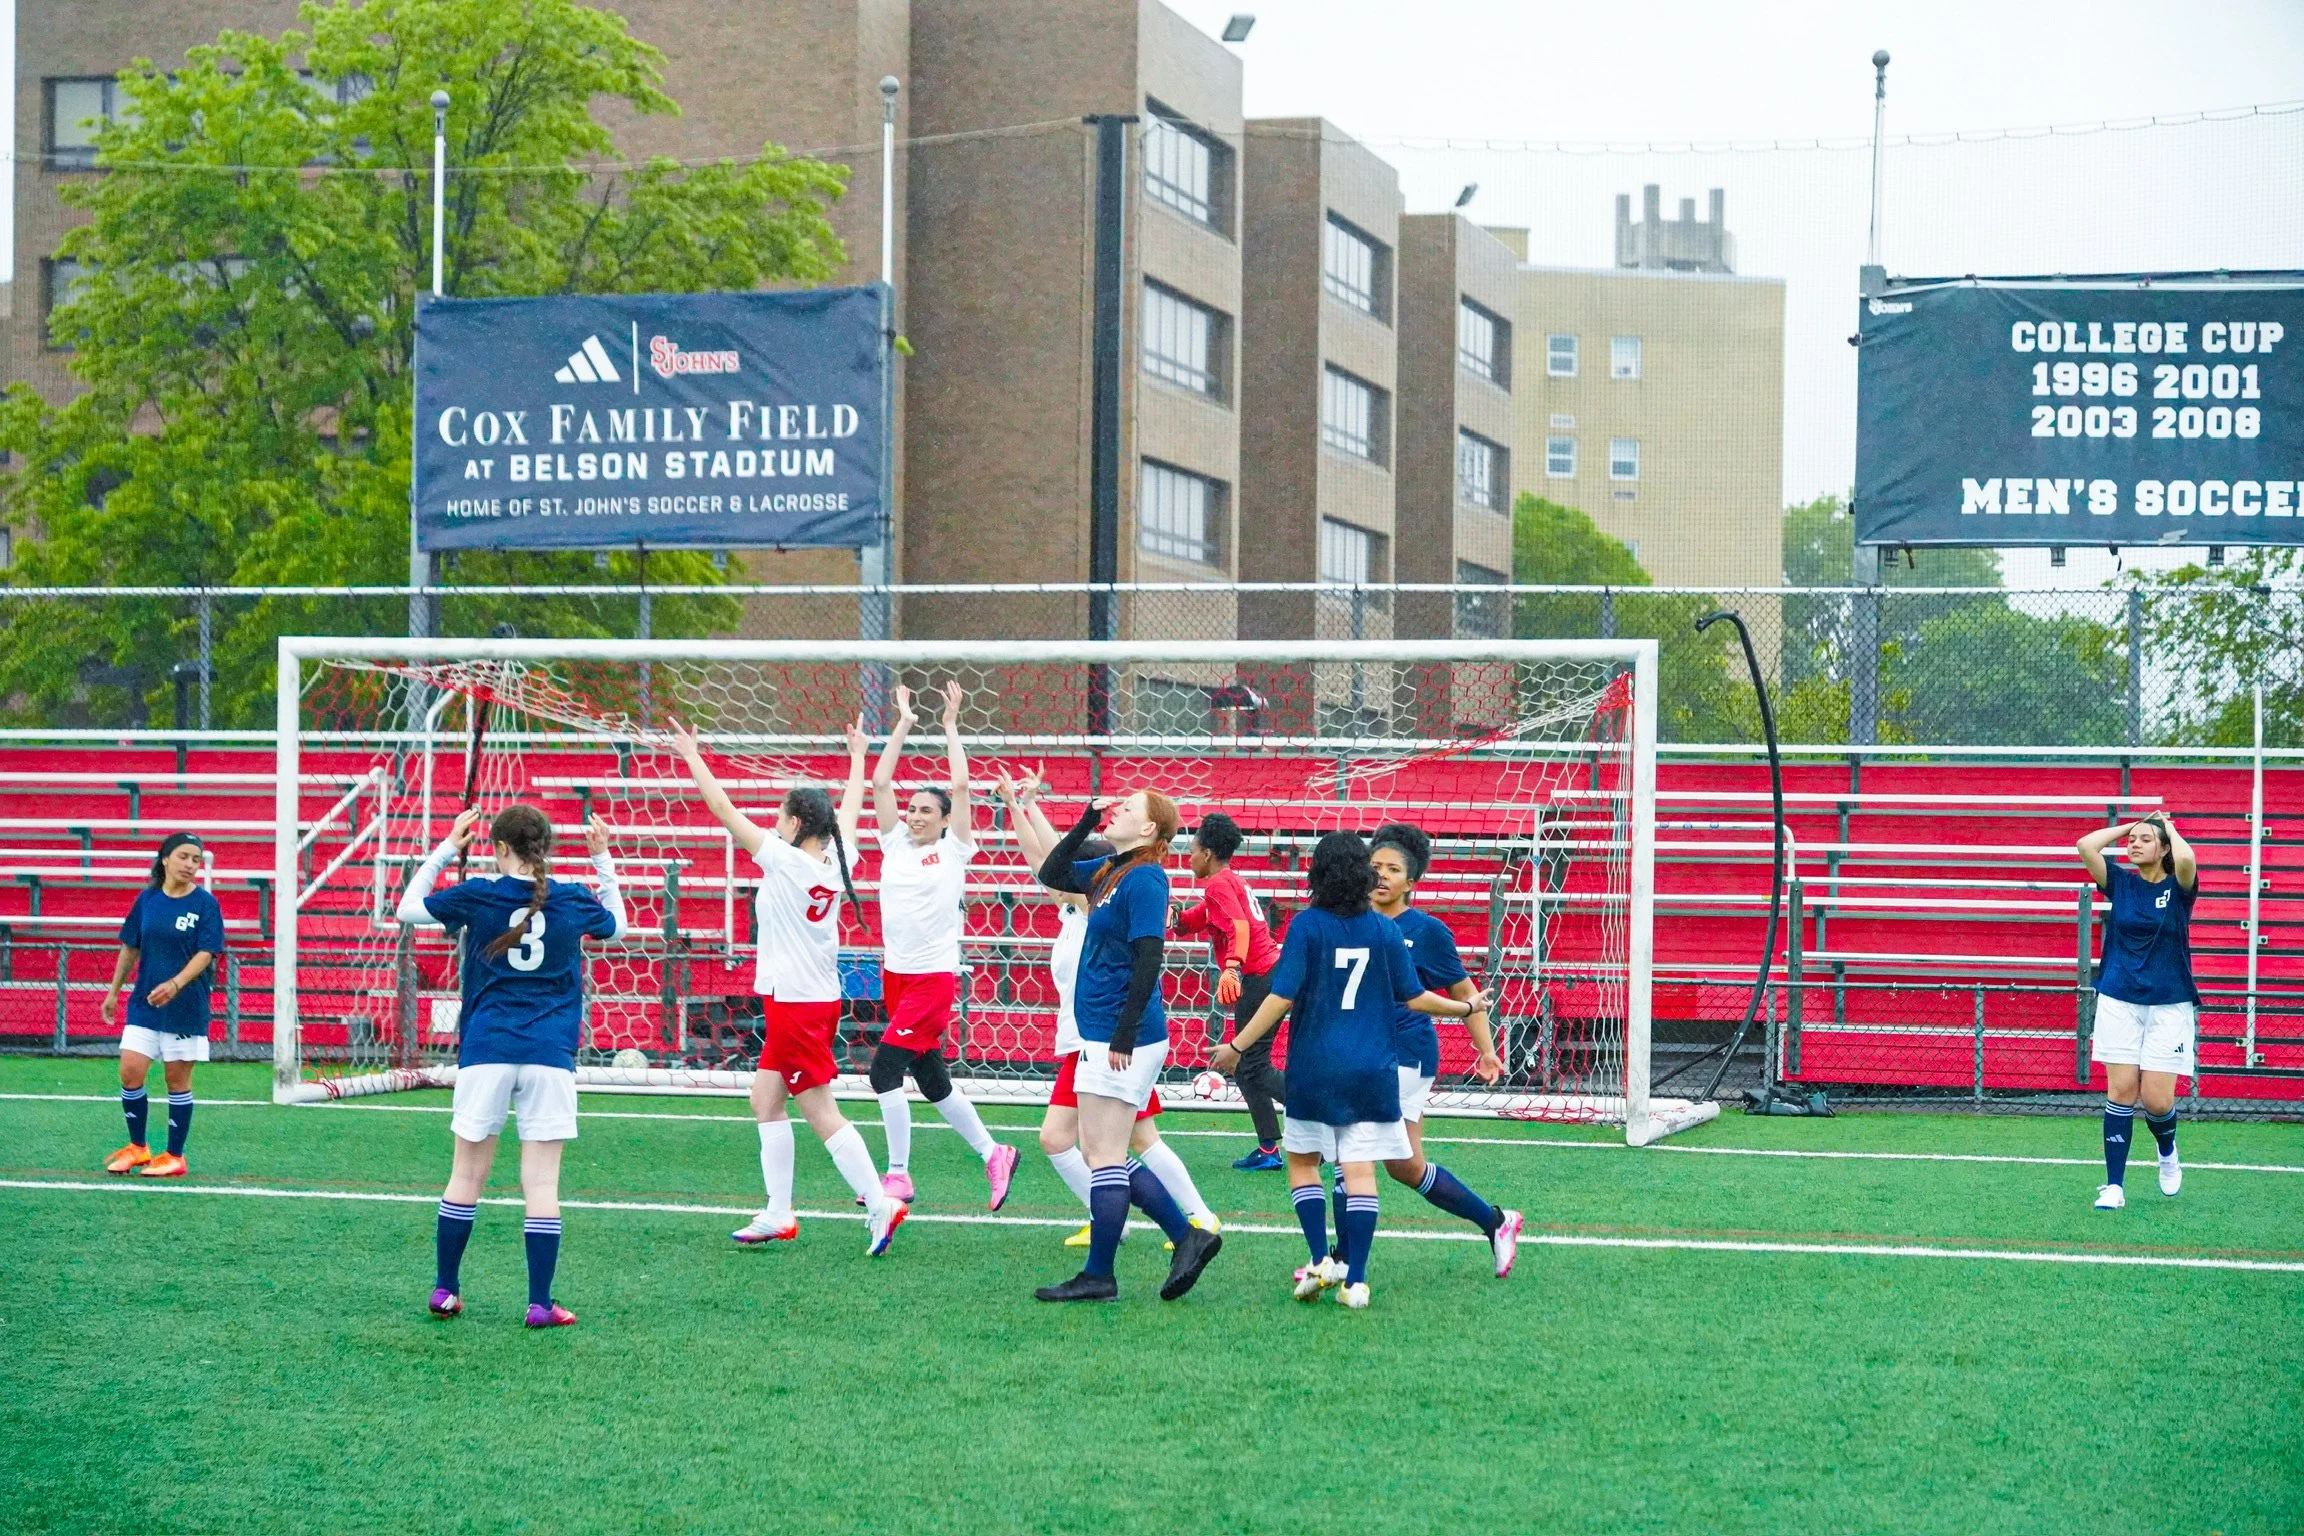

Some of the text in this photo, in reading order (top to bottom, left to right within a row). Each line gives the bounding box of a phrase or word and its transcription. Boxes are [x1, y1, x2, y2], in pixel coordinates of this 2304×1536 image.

[2012, 321, 2284, 353] COLLEGE CUP
[2032, 361, 2261, 399] 1996 2001
[439, 400, 859, 447] COX FAMILY FIELD
[2031, 405, 2261, 439] 2003 2008
[464, 448, 835, 482] AT BELSON STADIUM
[446, 492, 849, 517] HOME OF ST. JOHN'S SOCCER & LACROSSE
[1961, 477, 2304, 518] MEN'S SOCCE
[175, 912, 200, 931] GT
[507, 907, 546, 971] 3
[1334, 947, 1370, 1010] 7
